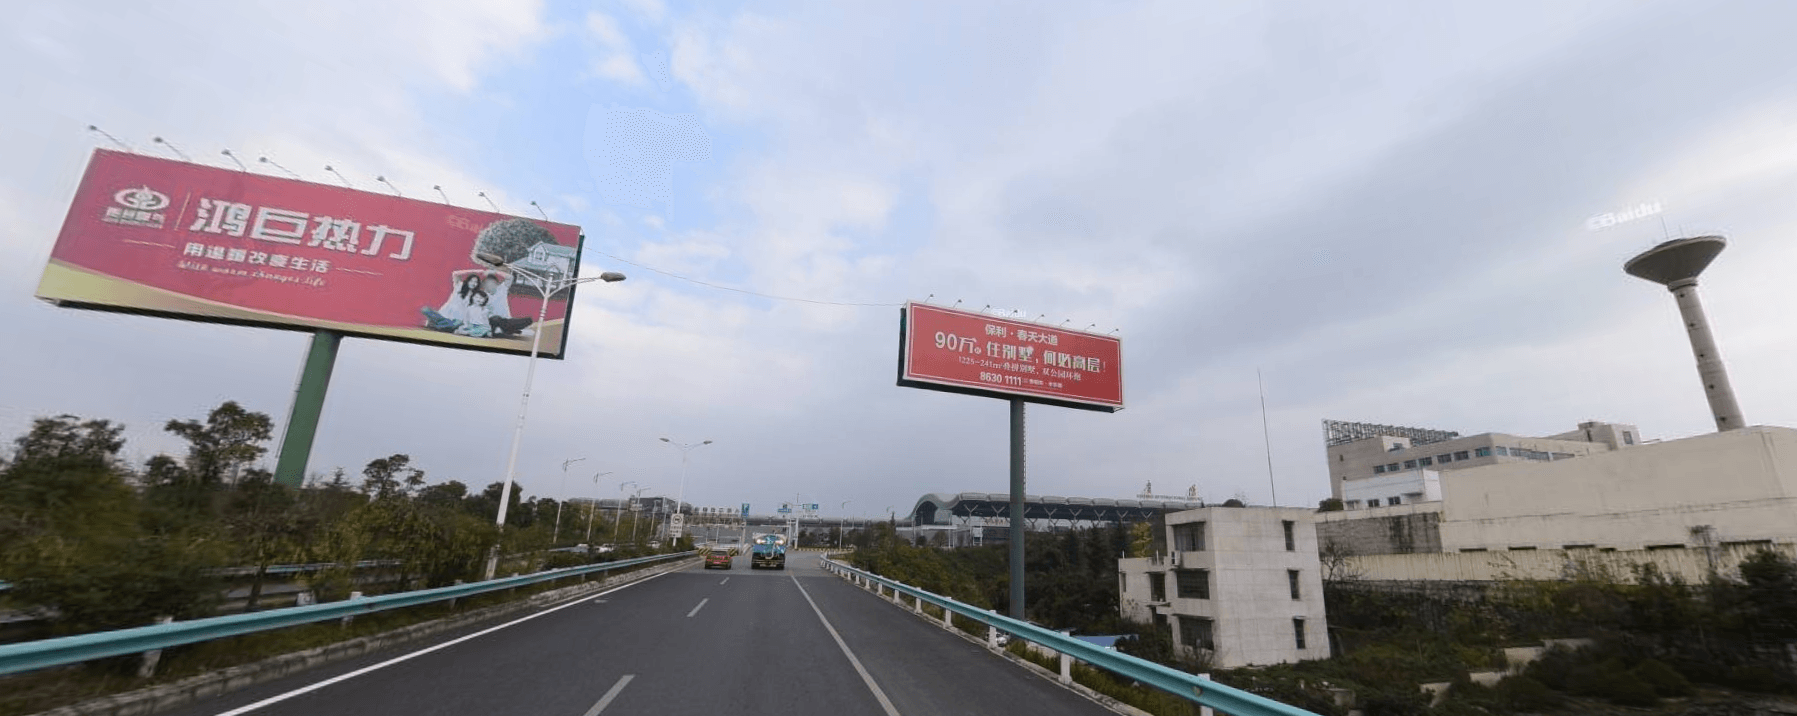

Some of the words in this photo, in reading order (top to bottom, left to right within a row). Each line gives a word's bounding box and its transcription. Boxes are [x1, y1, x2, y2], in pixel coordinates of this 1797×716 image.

[189, 197, 415, 261] 鸿巨热力
[980, 371, 1002, 384] 8630
[1005, 375, 1022, 386] 1111
